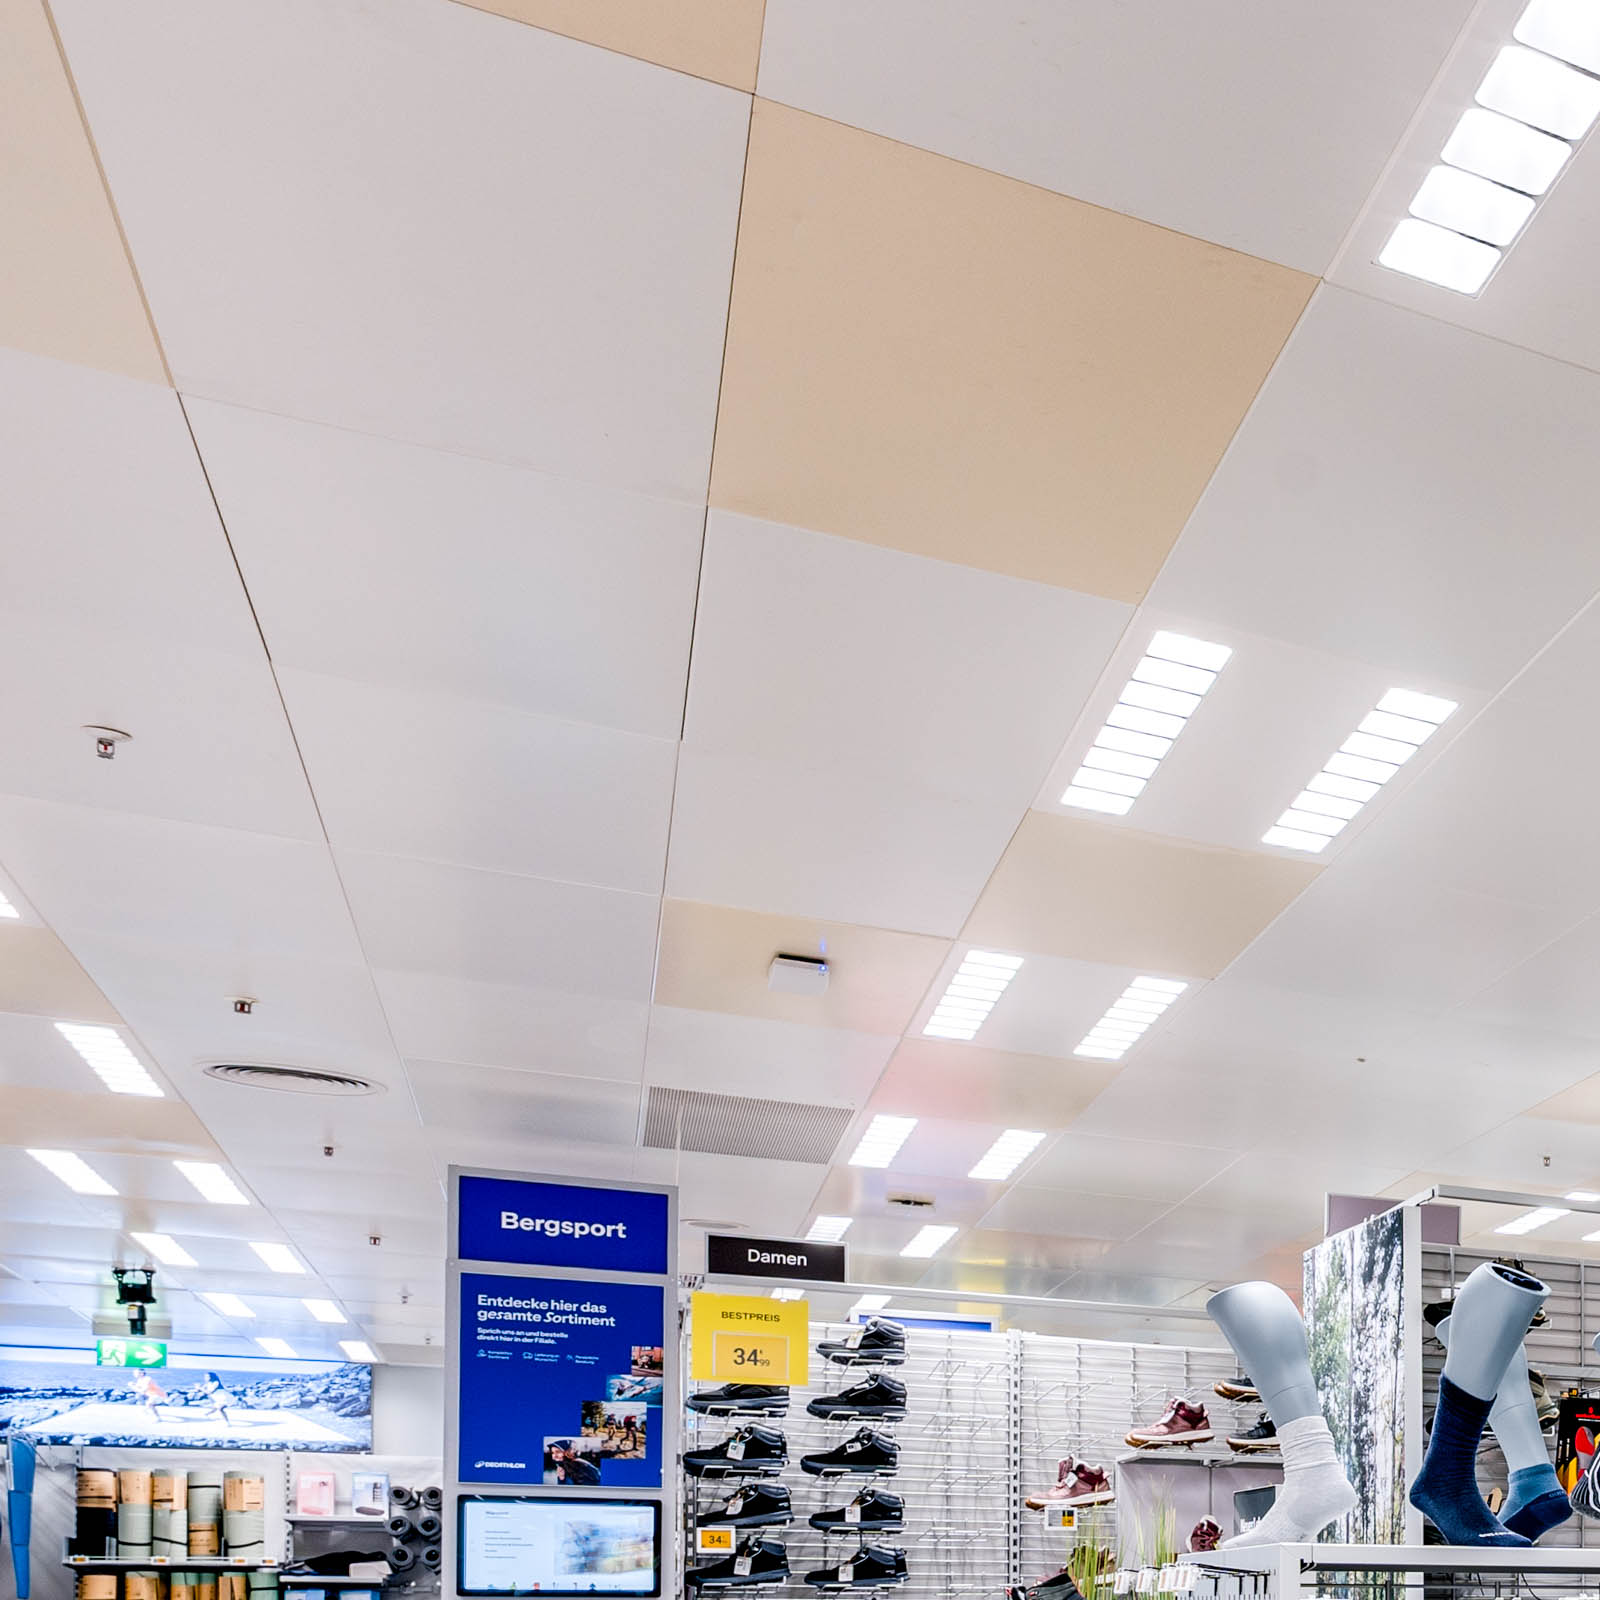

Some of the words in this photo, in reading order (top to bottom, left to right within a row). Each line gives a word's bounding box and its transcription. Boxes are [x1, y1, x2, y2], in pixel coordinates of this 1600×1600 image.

[502, 1212, 626, 1238] Bergsport
[748, 1249, 807, 1266] Damen
[477, 1294, 549, 1310] Entdecke
[551, 1299, 579, 1312] hier
[580, 1302, 607, 1314] das
[476, 1309, 542, 1322] gesamte
[544, 1312, 616, 1327] Sortiment
[721, 1311, 780, 1323] BESTPREIS
[733, 1348, 759, 1366] 34
[709, 1536, 722, 1544] 34
